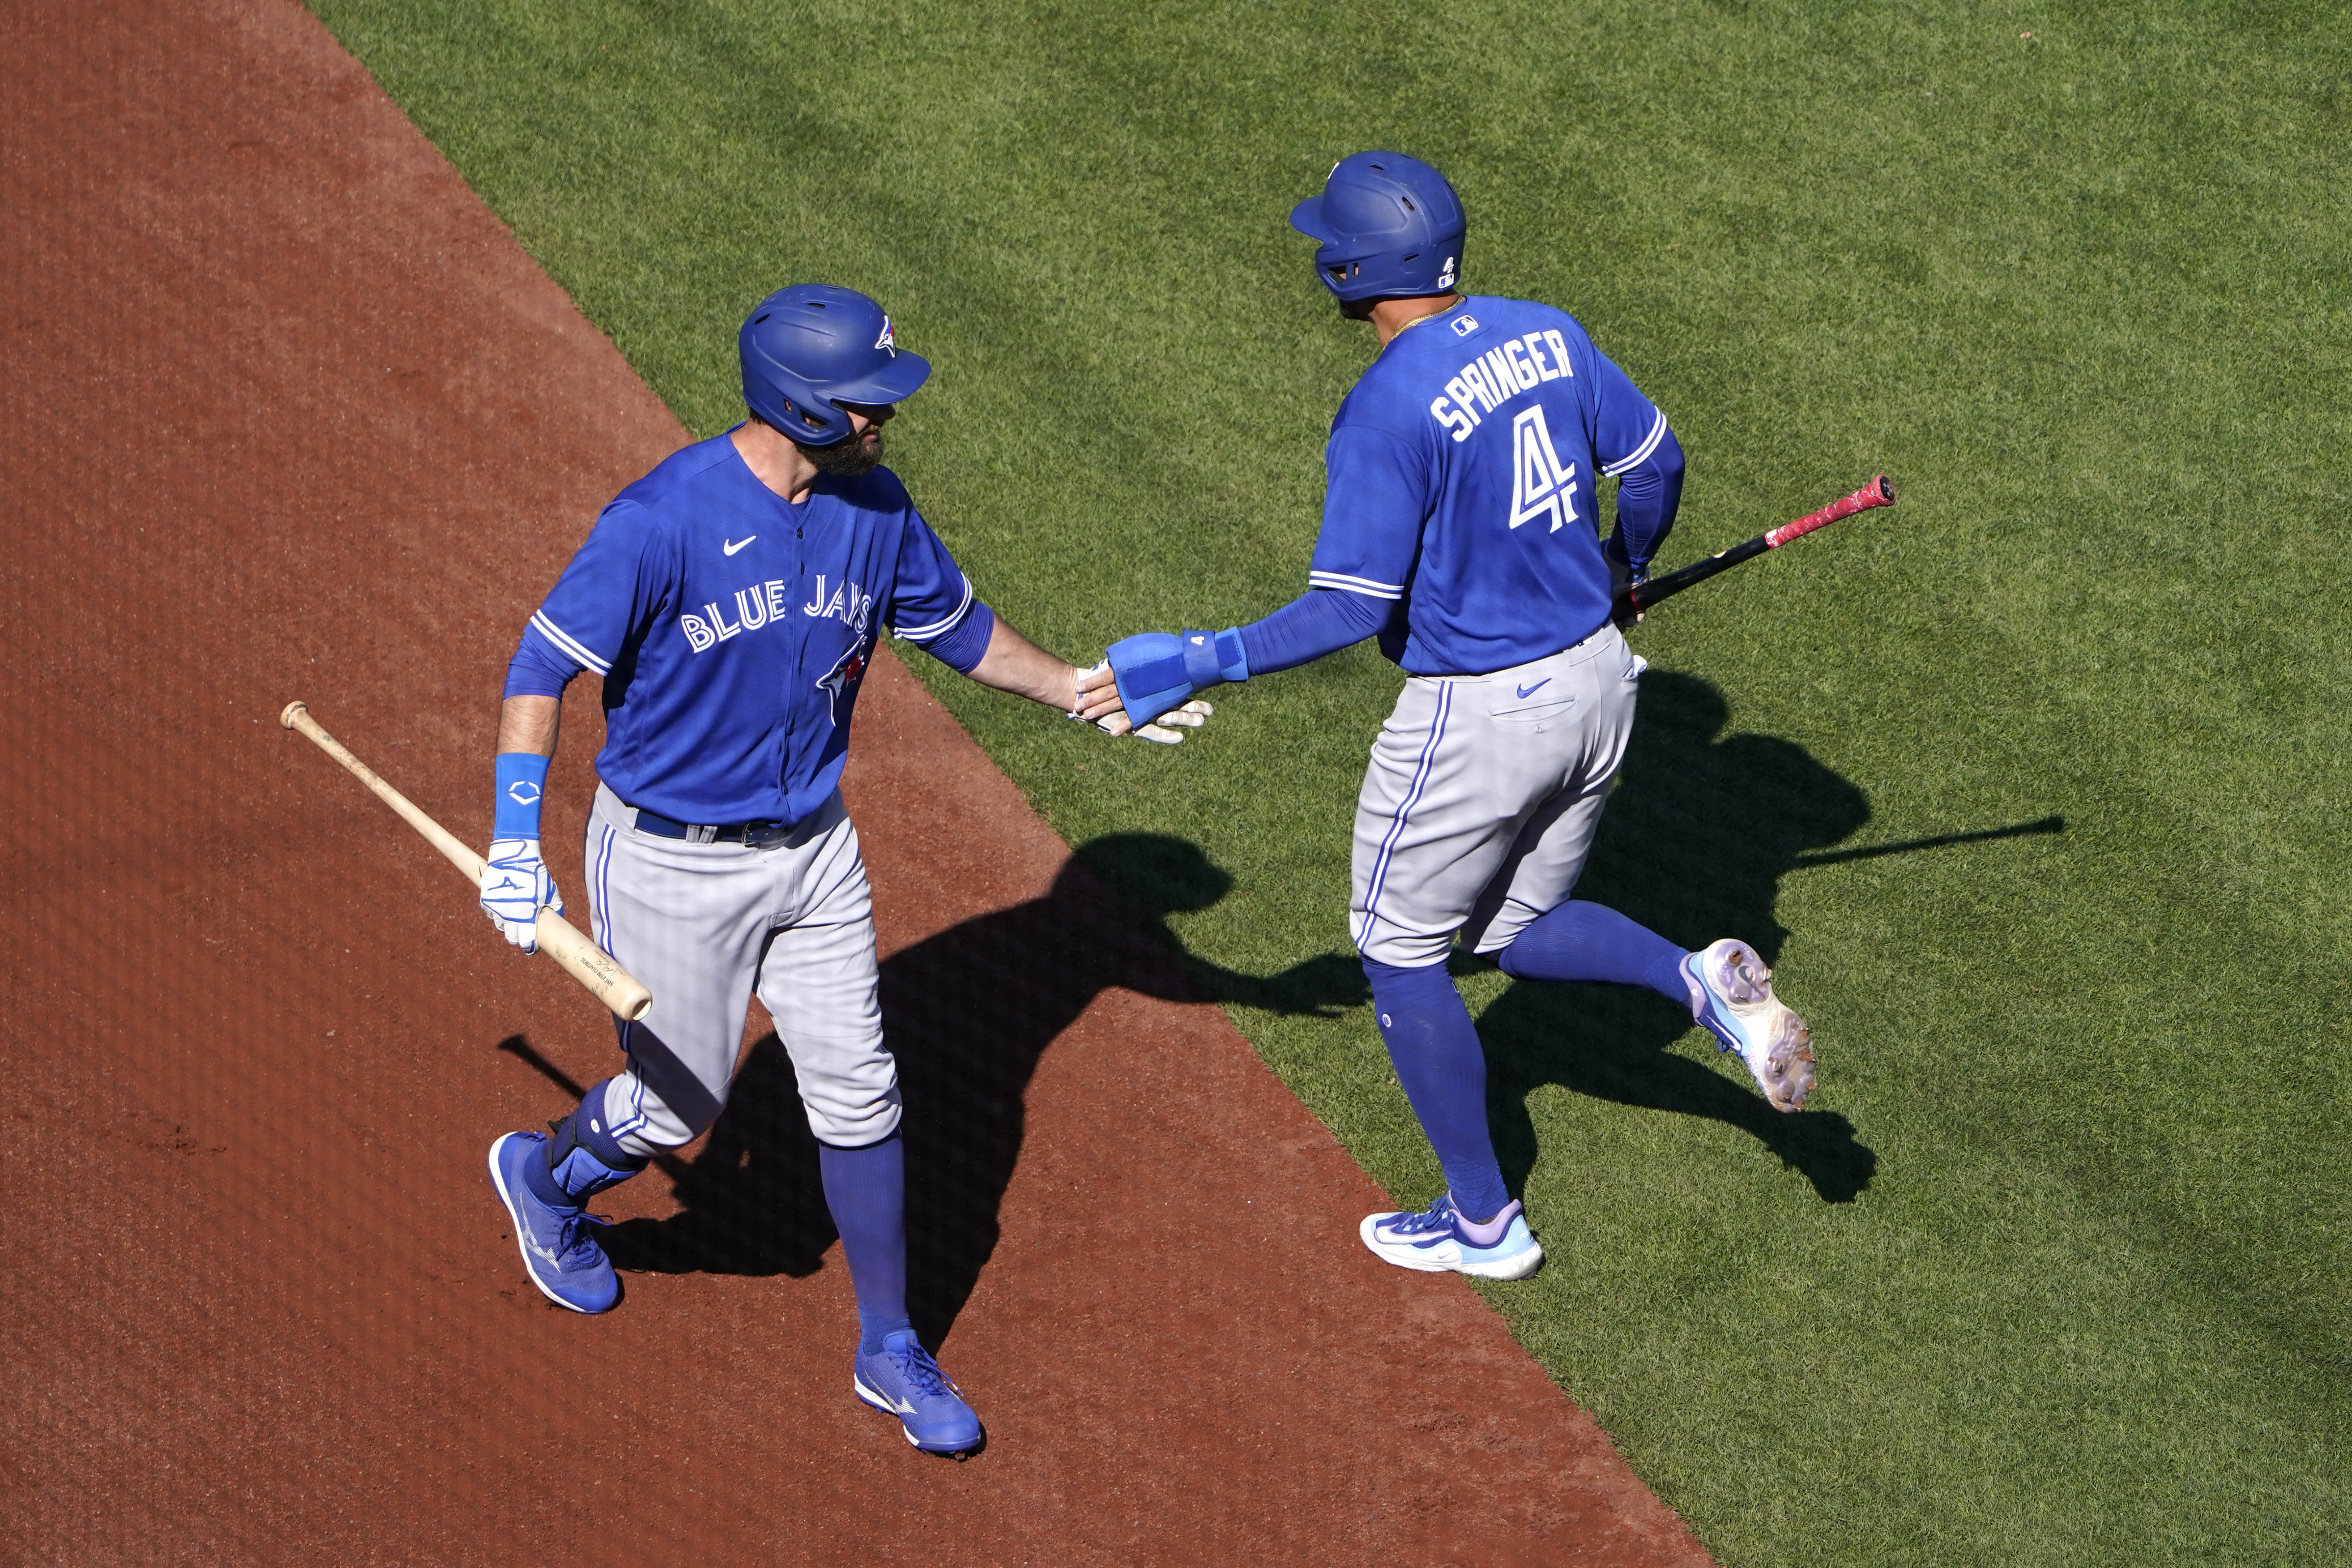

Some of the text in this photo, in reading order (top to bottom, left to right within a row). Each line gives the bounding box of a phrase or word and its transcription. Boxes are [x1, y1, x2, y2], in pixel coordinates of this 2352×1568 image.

[1443, 257, 1454, 273] 4
[1430, 329, 1574, 442] SPRINGER
[1509, 404, 1579, 534] 4
[681, 575, 872, 654] BLUE JAYS
[1191, 636, 1205, 645] 4
[581, 957, 598, 974] TORONTO
[597, 971, 607, 981] BLUE
[604, 978, 614, 987] JAYS
